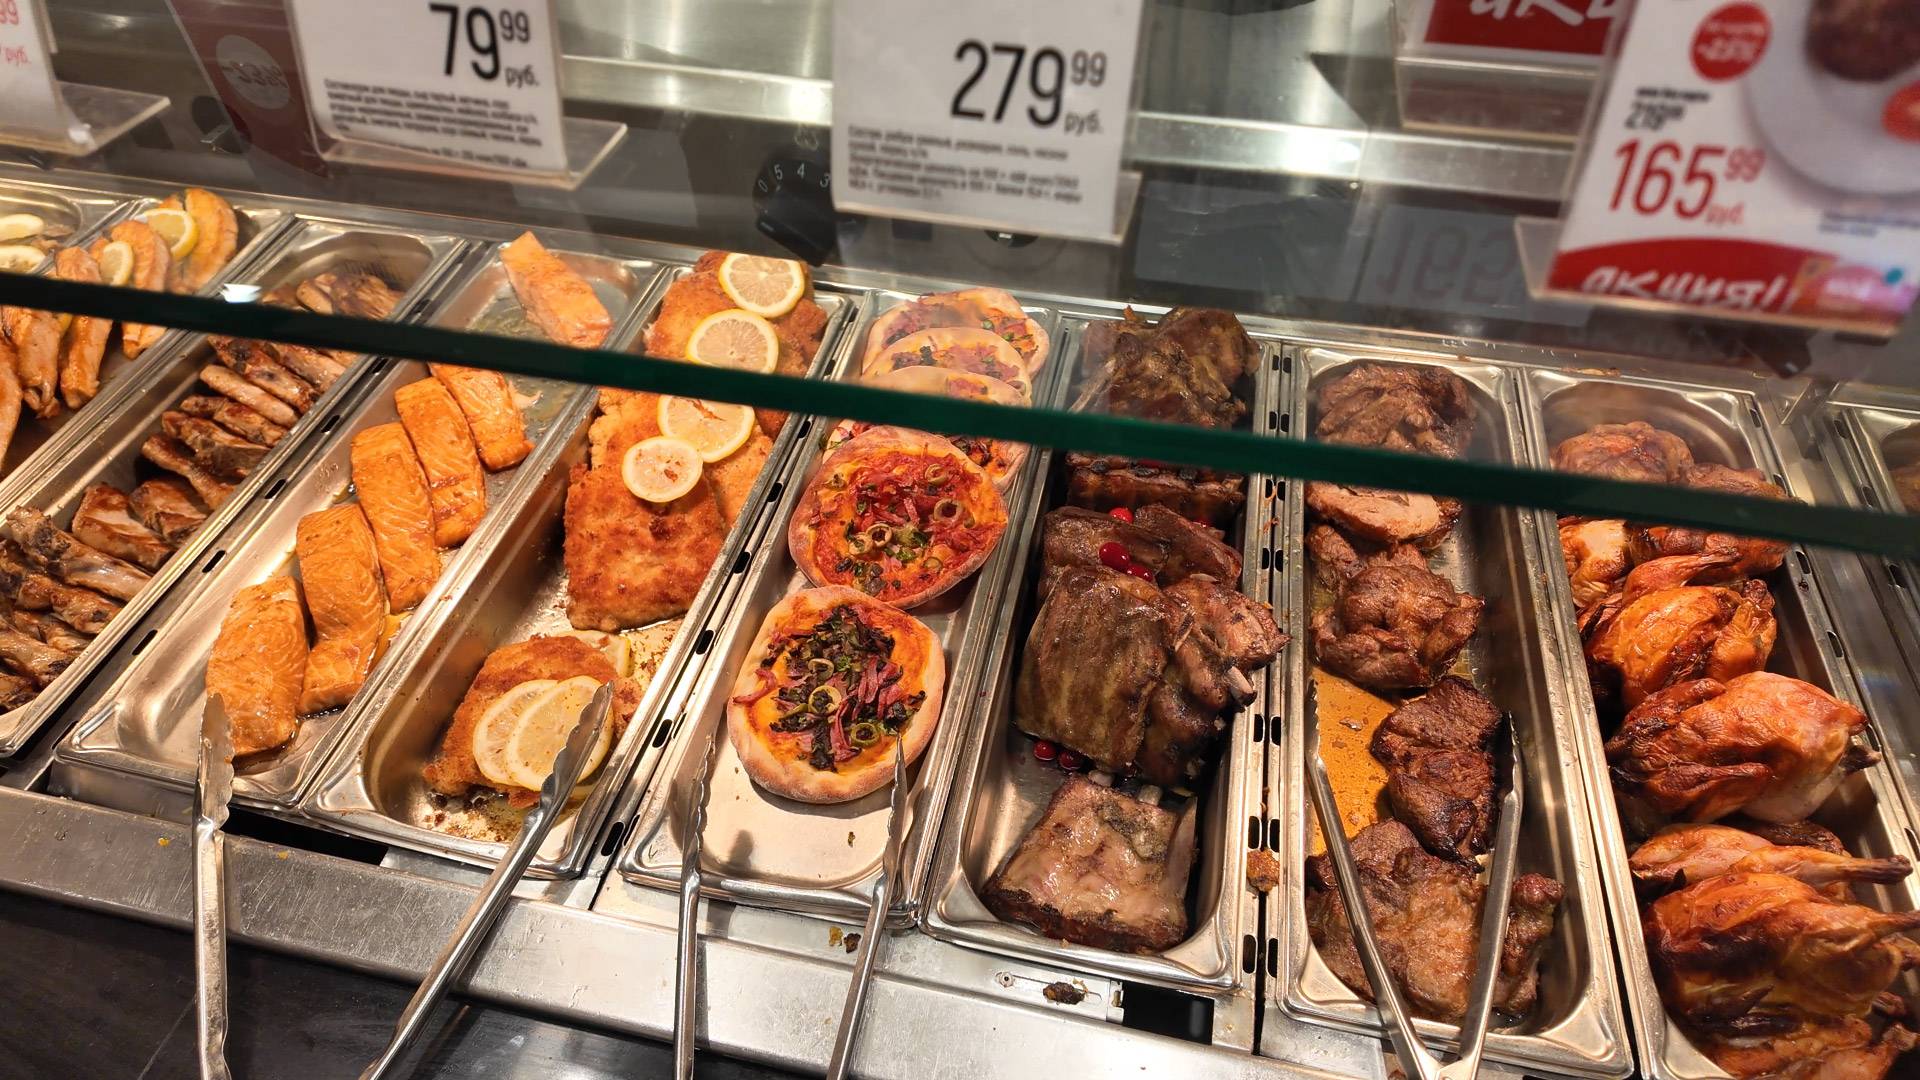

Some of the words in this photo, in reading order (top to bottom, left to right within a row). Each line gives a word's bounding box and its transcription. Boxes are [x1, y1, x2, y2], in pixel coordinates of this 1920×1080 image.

[428, 3, 500, 81] 79
[499, 8, 530, 44] 99
[504, 64, 540, 90] руб.
[950, 39, 1066, 128] 279
[1071, 49, 1107, 87] 99
[1063, 109, 1105, 136] руб.
[773, 164, 783, 181] 5
[797, 162, 806, 179] 4
[1608, 137, 1726, 220] 165
[1724, 145, 1768, 184] 99
